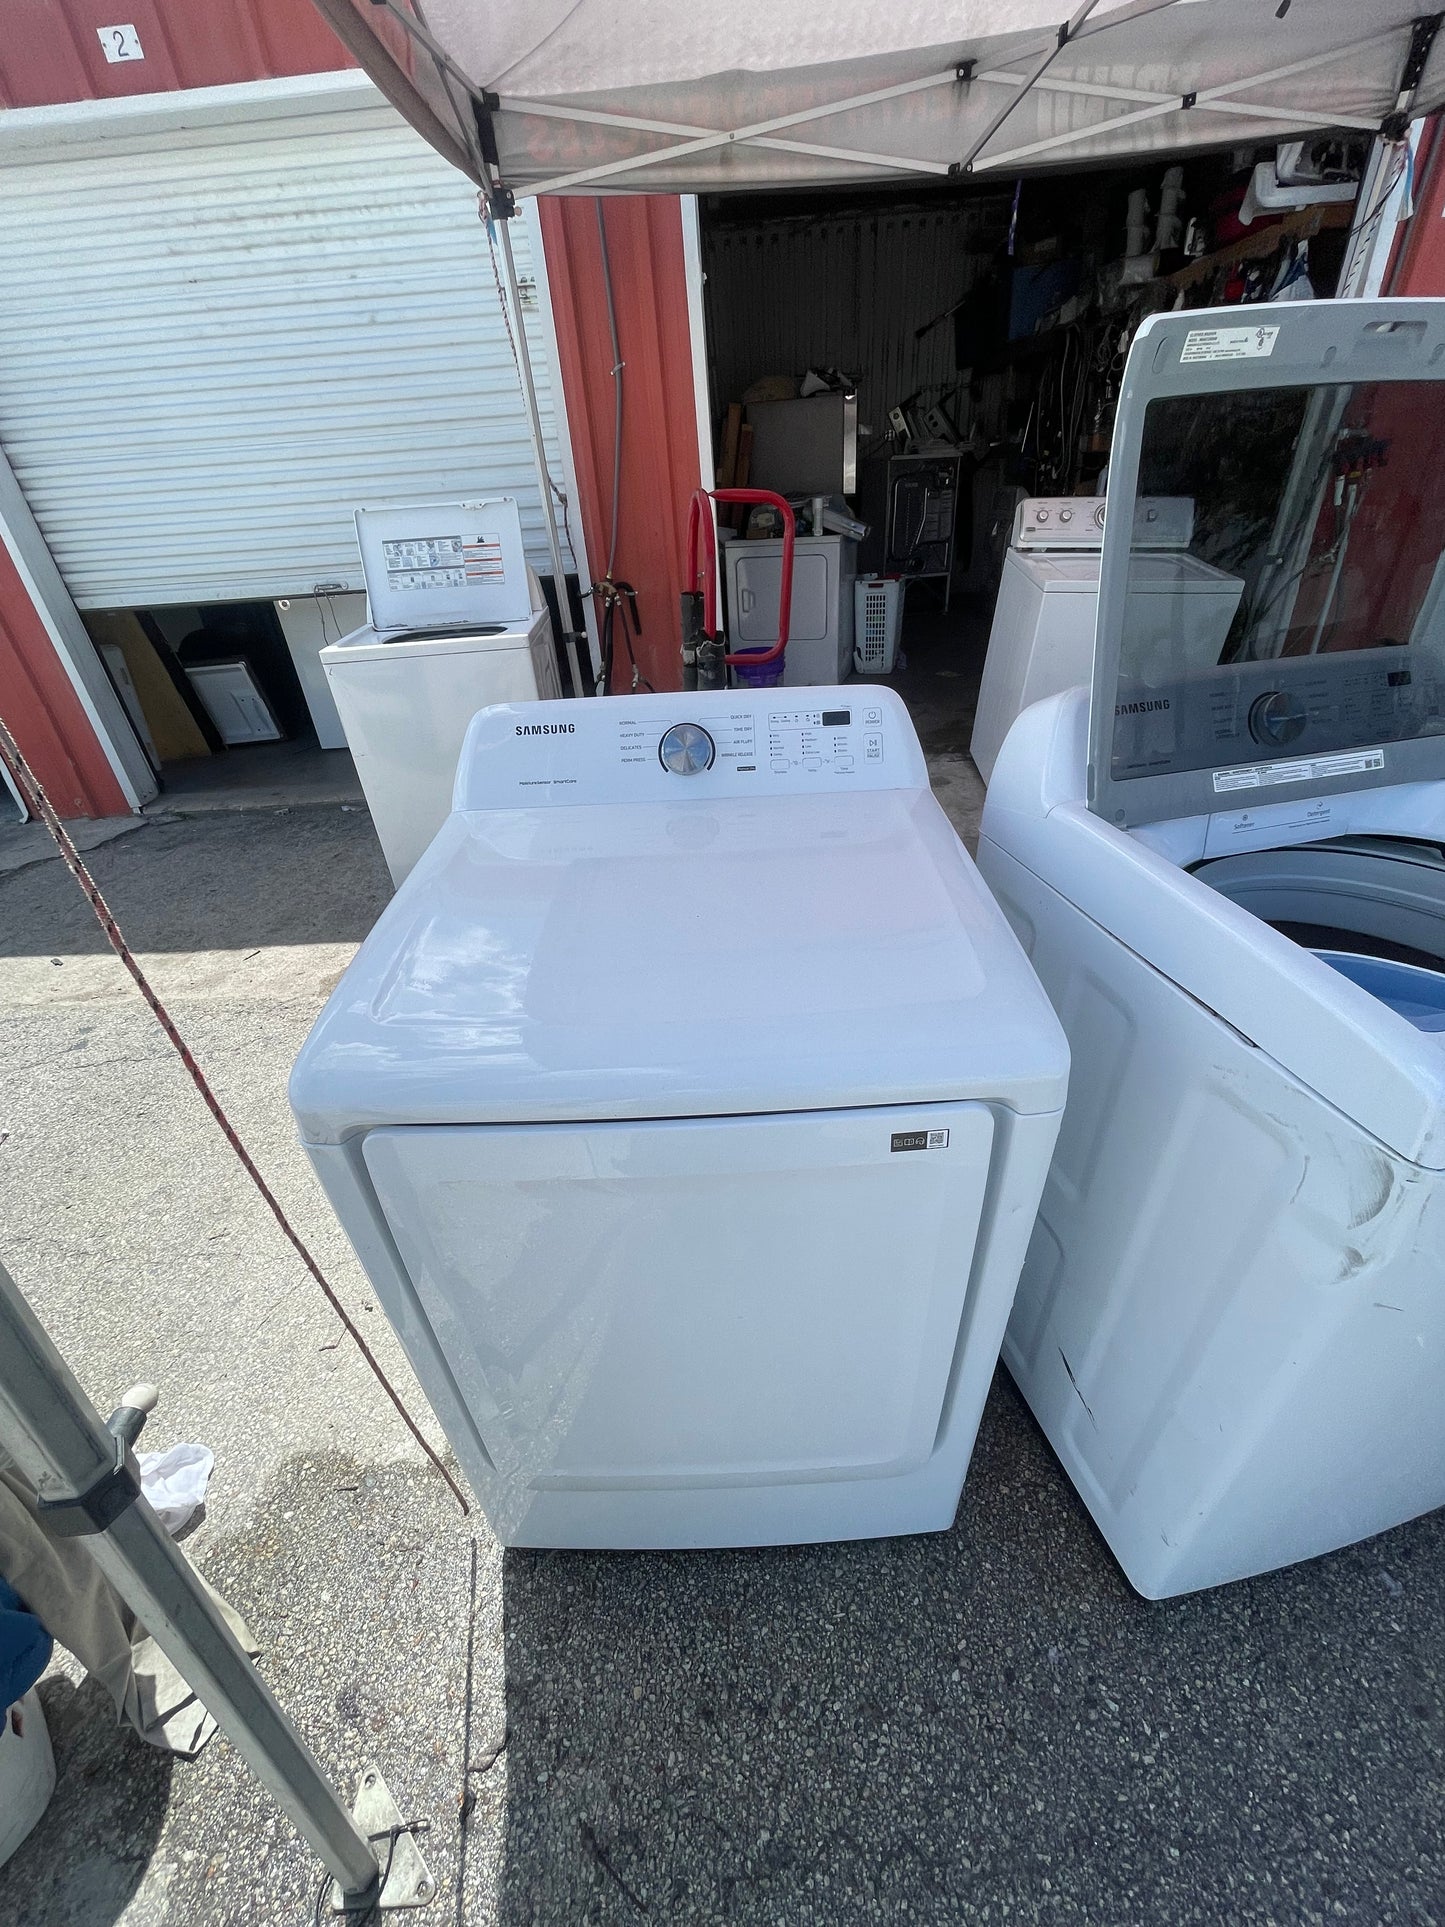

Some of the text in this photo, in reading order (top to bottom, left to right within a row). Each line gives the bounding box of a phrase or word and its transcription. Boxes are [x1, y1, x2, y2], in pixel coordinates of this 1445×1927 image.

[112, 30, 129, 57] 2
[1114, 699, 1170, 716] SAMSUNG
[515, 723, 576, 736] SAMSUNG
[1307, 808, 1331, 817] Detergent
